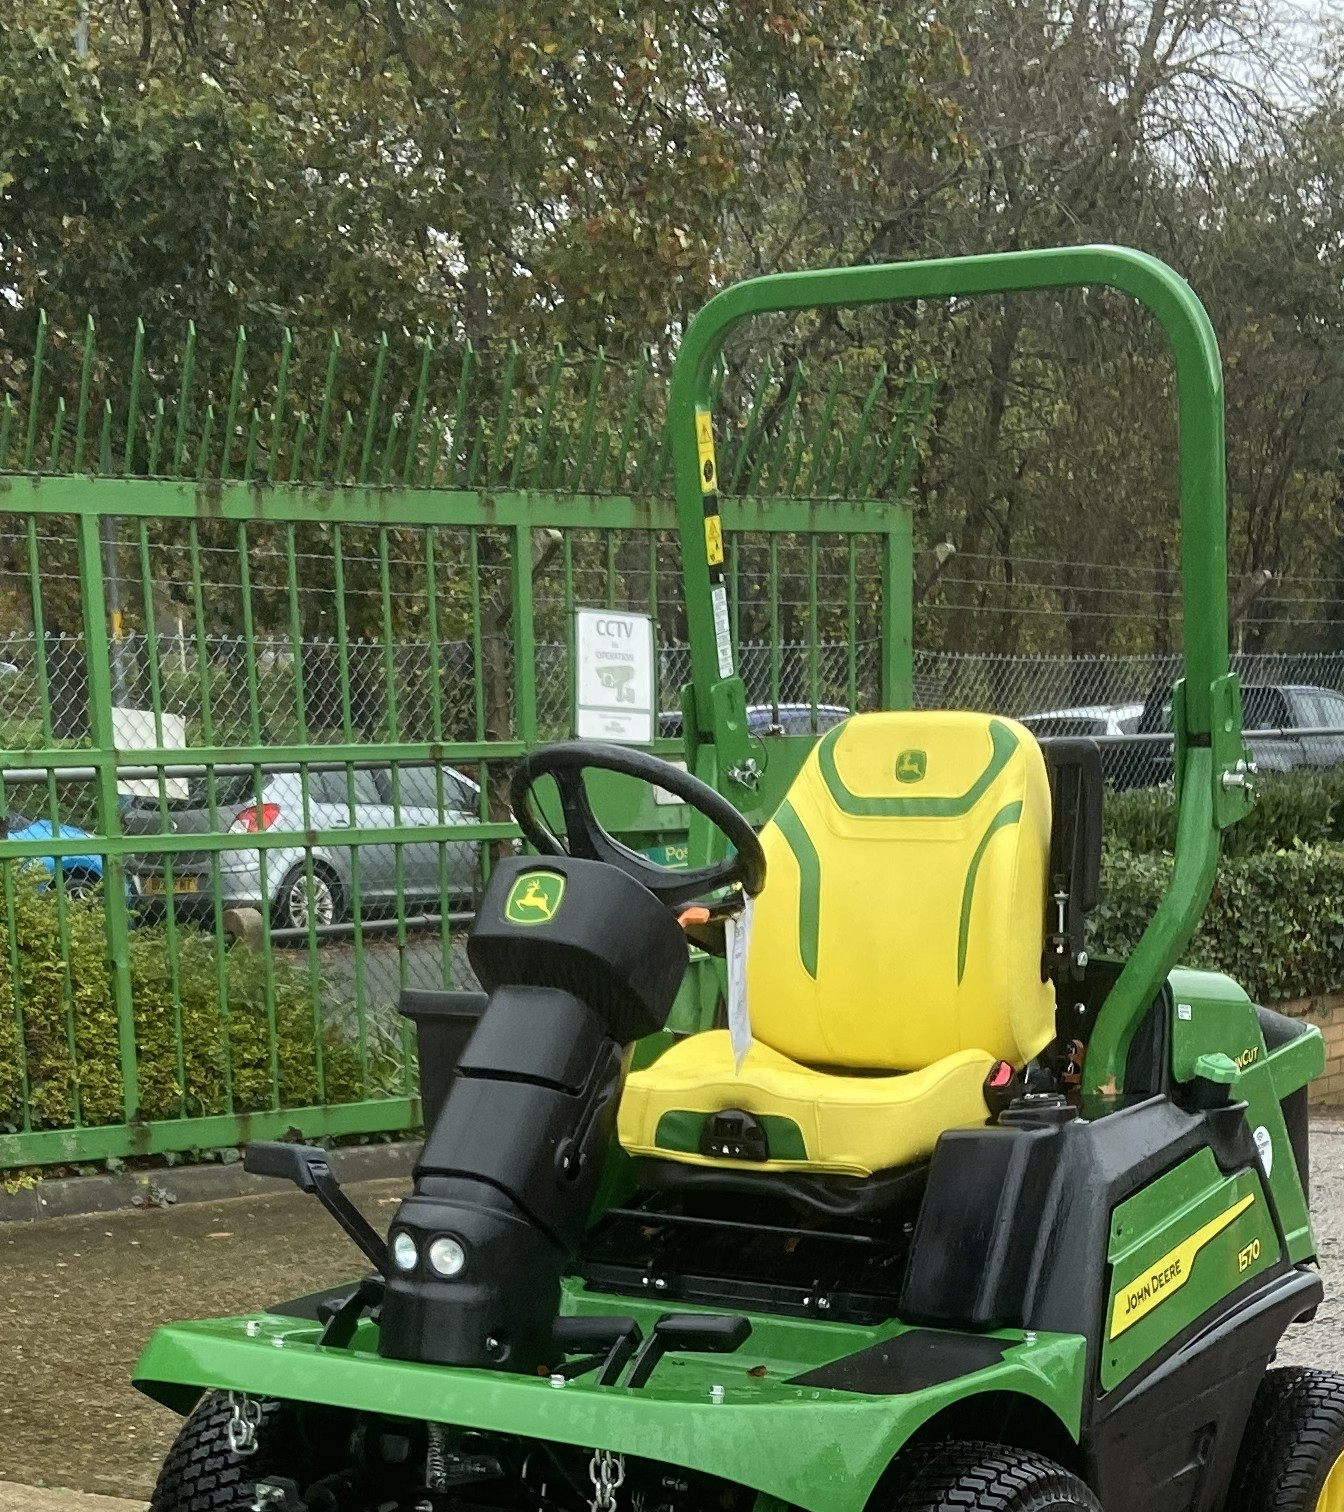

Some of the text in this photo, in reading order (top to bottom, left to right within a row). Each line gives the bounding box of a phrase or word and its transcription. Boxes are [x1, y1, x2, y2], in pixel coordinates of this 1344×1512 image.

[596, 619, 634, 639] CCTV
[1238, 1238, 1261, 1273] 1570
[1125, 1258, 1182, 1314] JOHN DEERE
